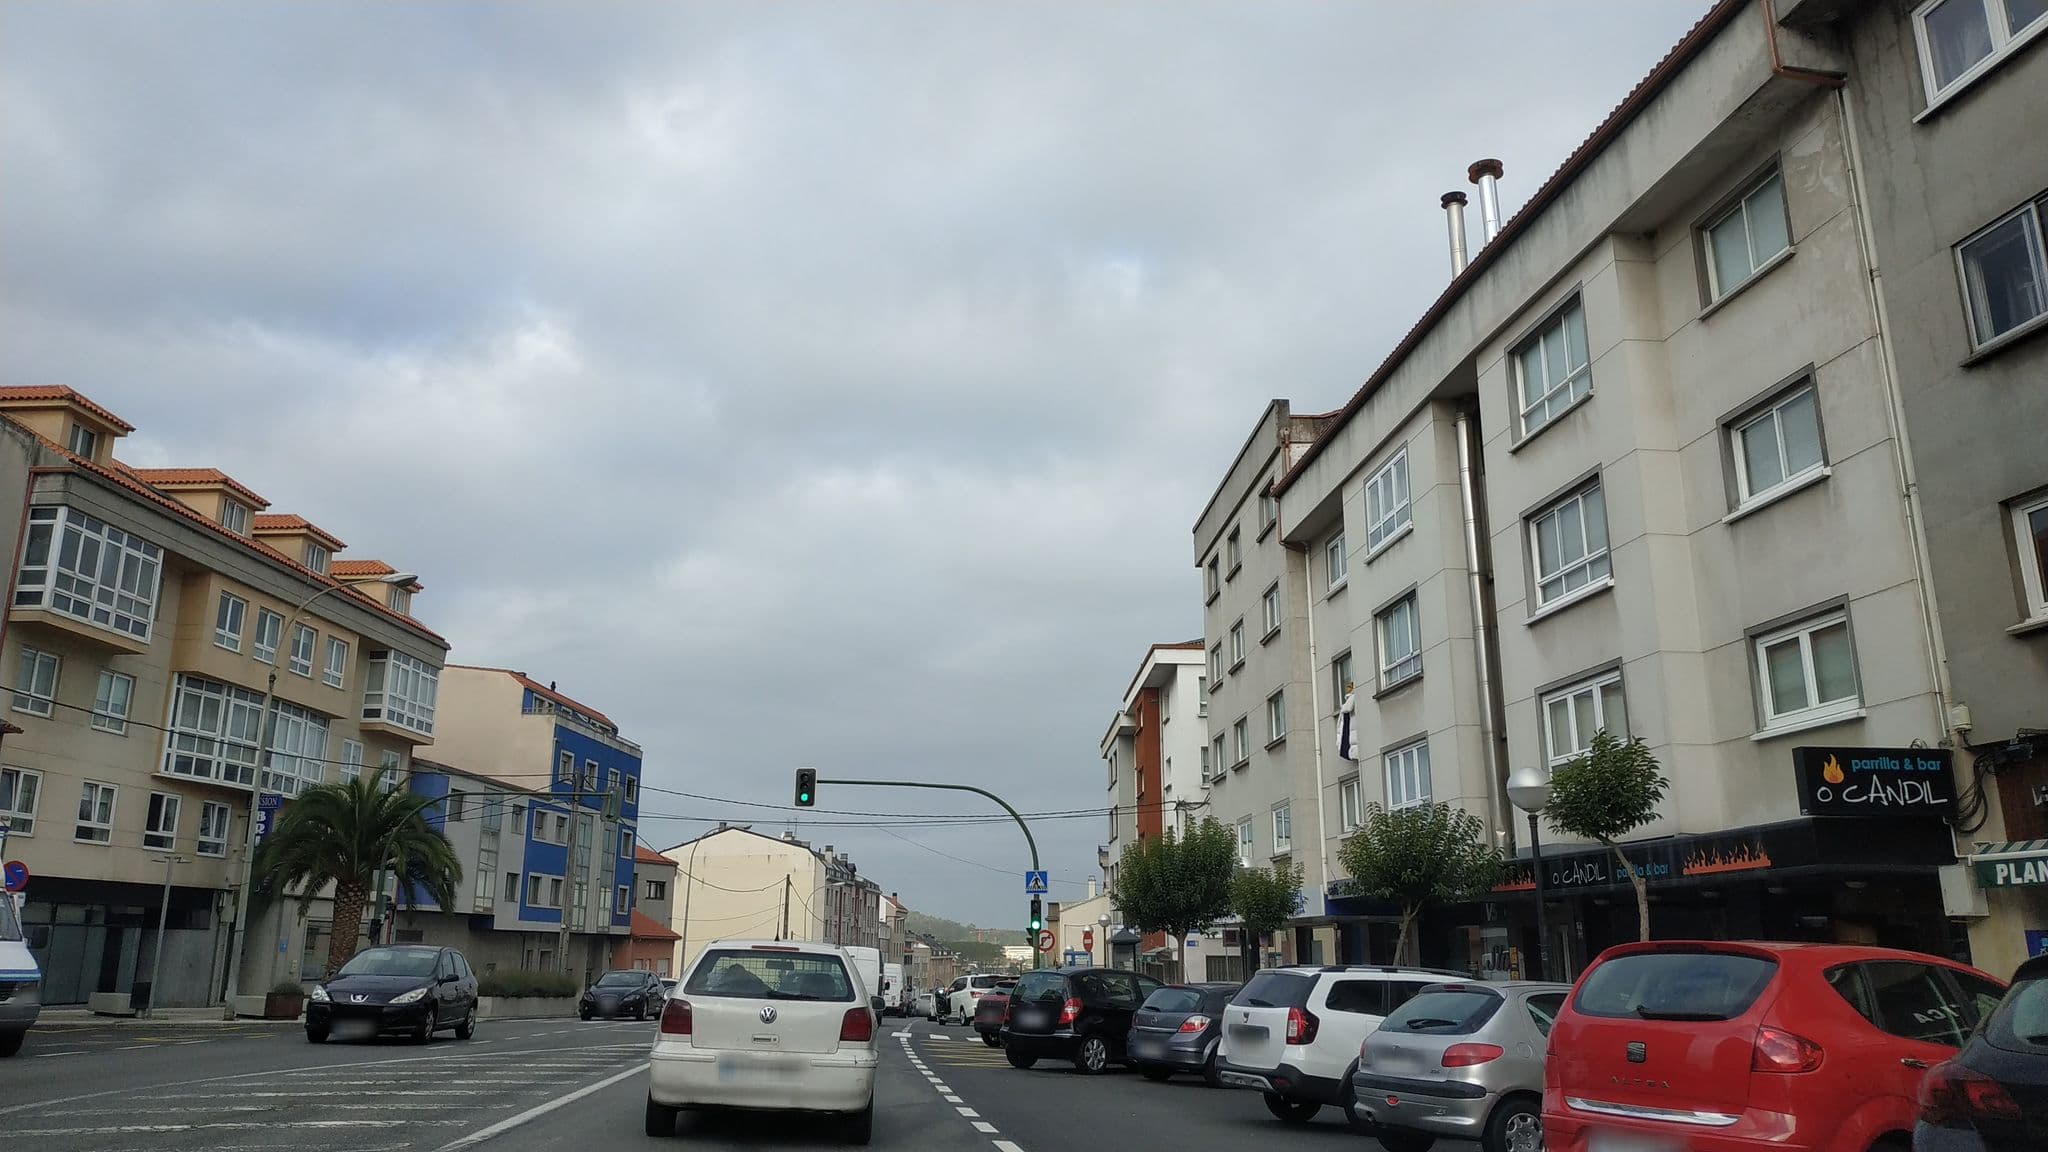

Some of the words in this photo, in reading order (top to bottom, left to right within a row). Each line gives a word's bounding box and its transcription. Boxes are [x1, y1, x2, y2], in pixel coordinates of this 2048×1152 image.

[1851, 757, 1900, 773] parrilla
[1904, 758, 1914, 771] &
[1917, 758, 1942, 771] bar
[1842, 774, 1949, 806] CANDIL
[1562, 861, 1607, 885] CANDIL
[1653, 862, 1669, 875] bar
